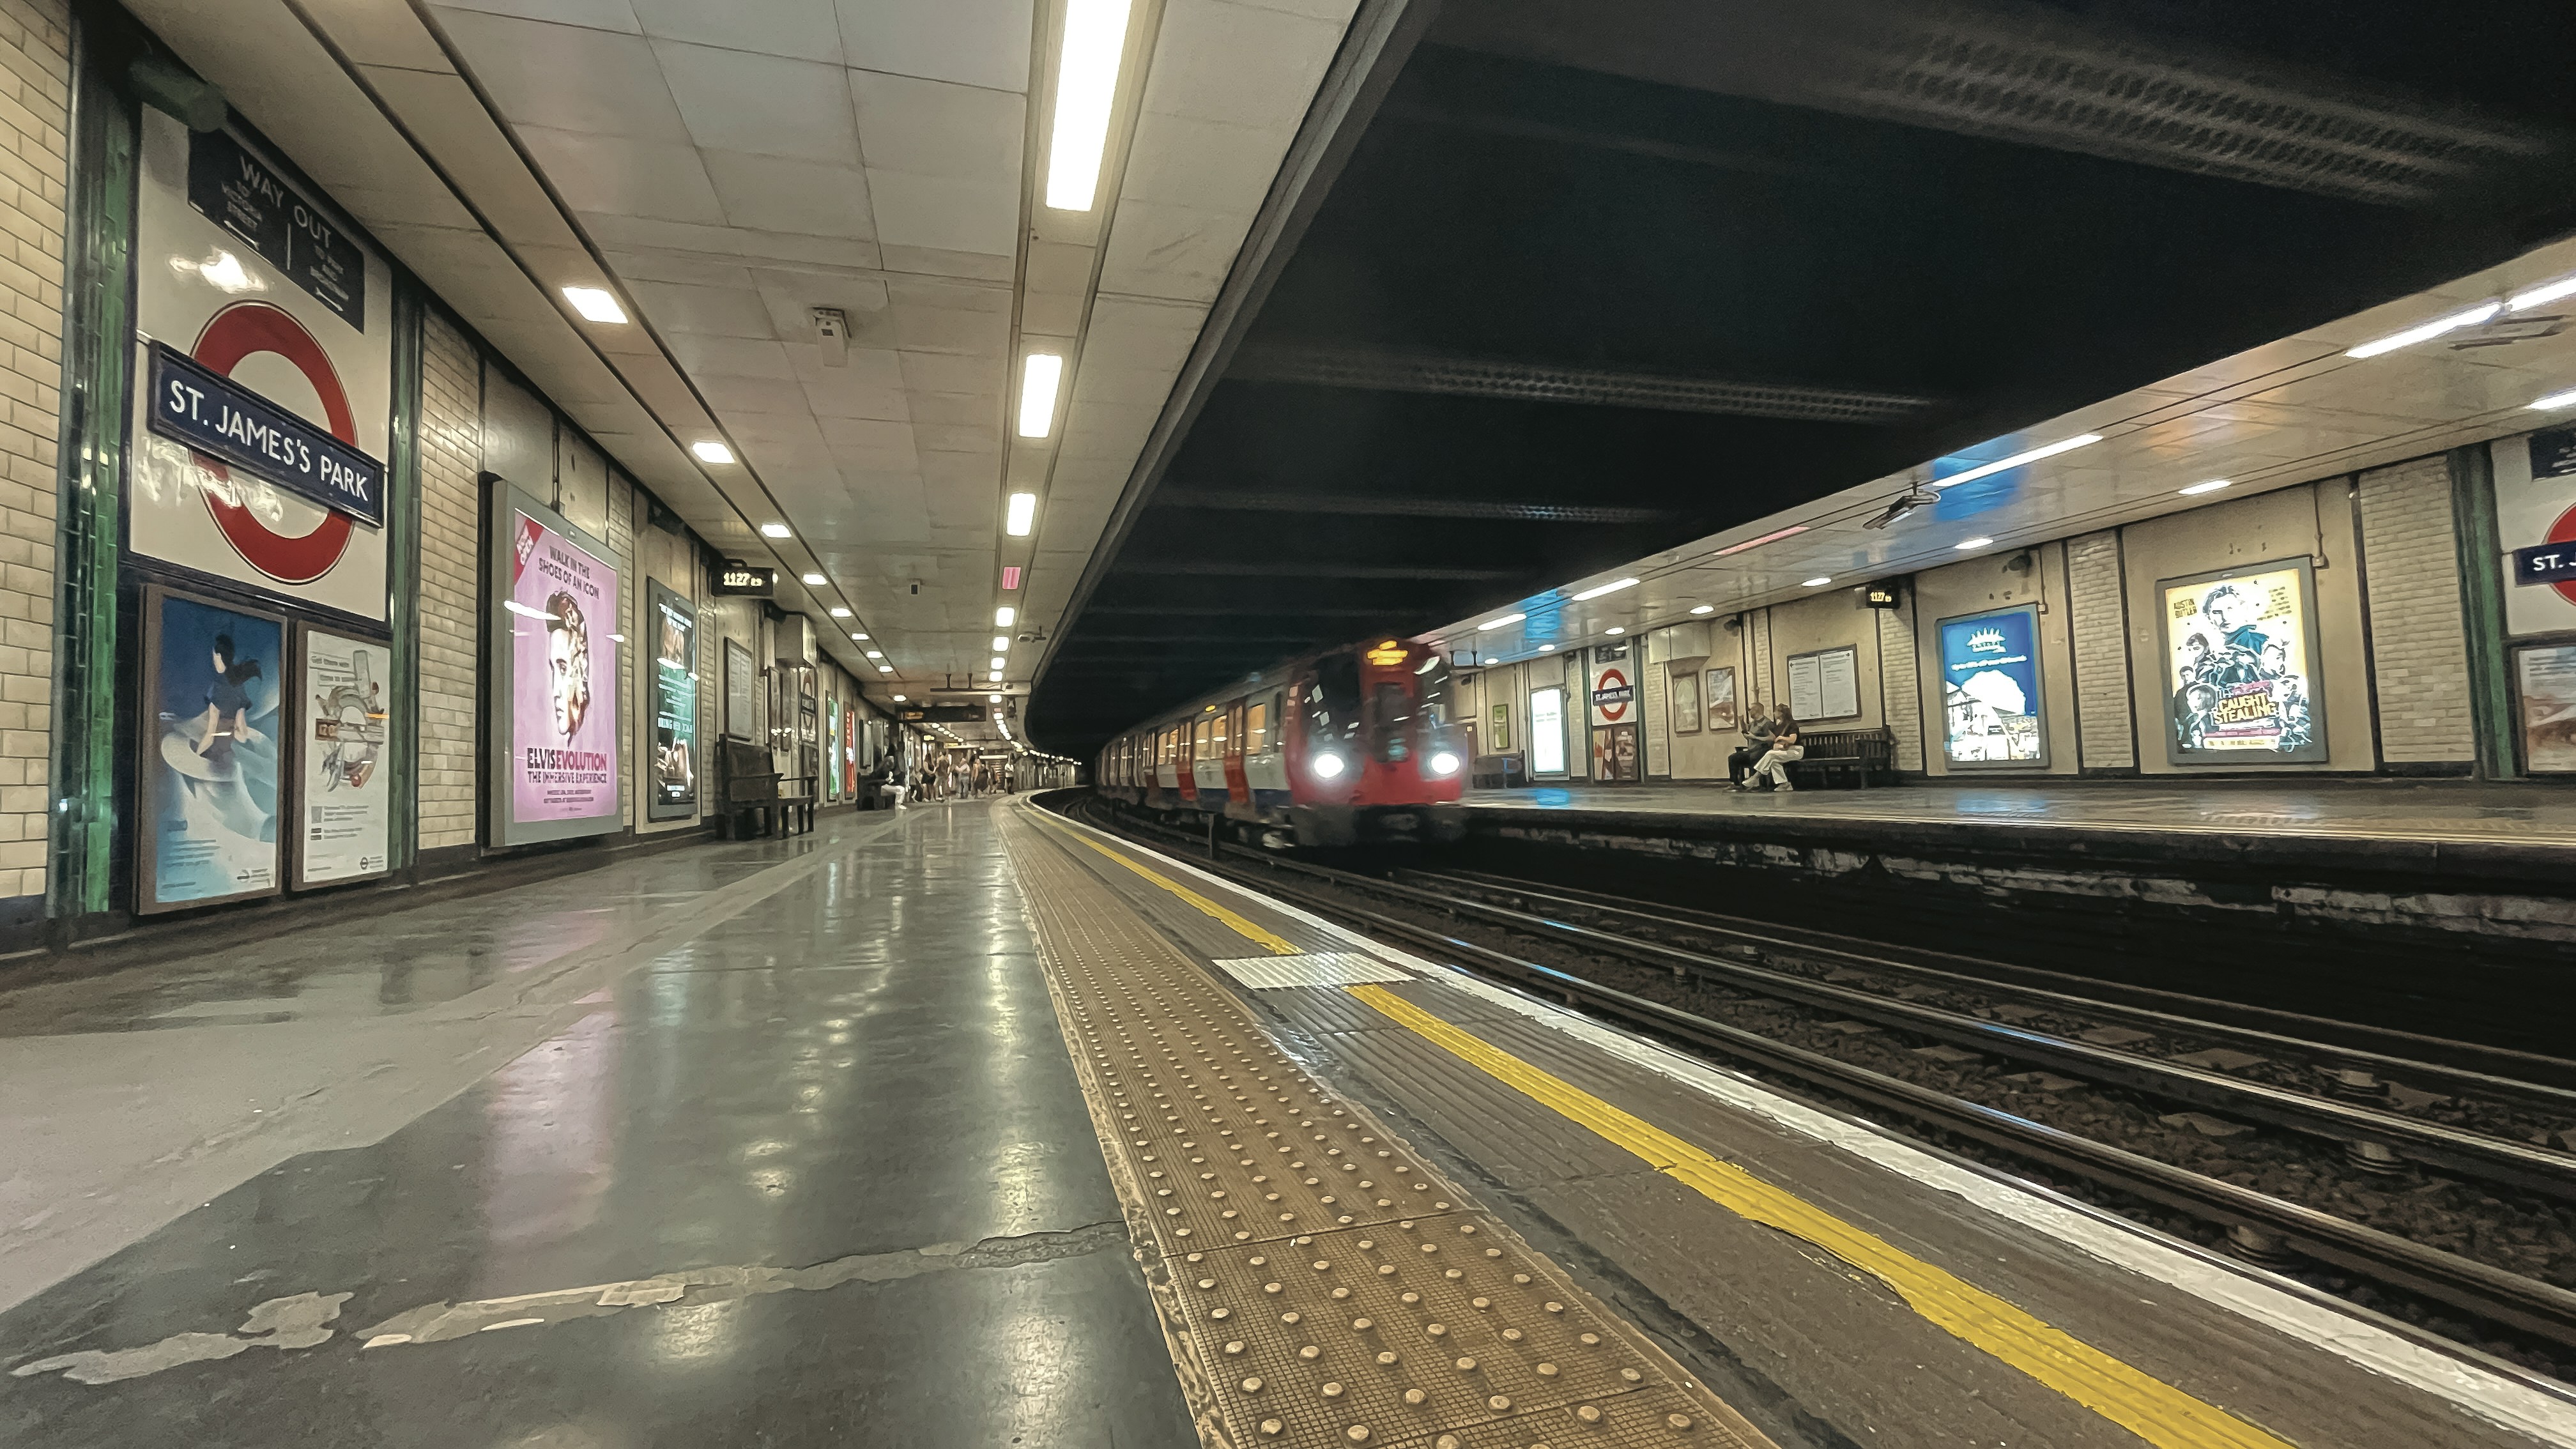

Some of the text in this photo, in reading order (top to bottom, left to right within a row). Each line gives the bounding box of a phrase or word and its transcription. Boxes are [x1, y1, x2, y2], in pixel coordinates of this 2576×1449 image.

[240, 155, 331, 248] WAY OUT
[169, 379, 369, 502] ST. JAMES'S PARK
[549, 546, 590, 579] WALK IN THE
[2533, 553, 2564, 571] ST.
[539, 557, 599, 600] SHOES OF AN ICON
[2214, 702, 2277, 724] STEALING
[2218, 692, 2268, 713] CAUGHT
[527, 747, 608, 771] ELVIS EVOLUTION
[528, 770, 541, 783] THE
[576, 772, 608, 785] EXPERIENCE
